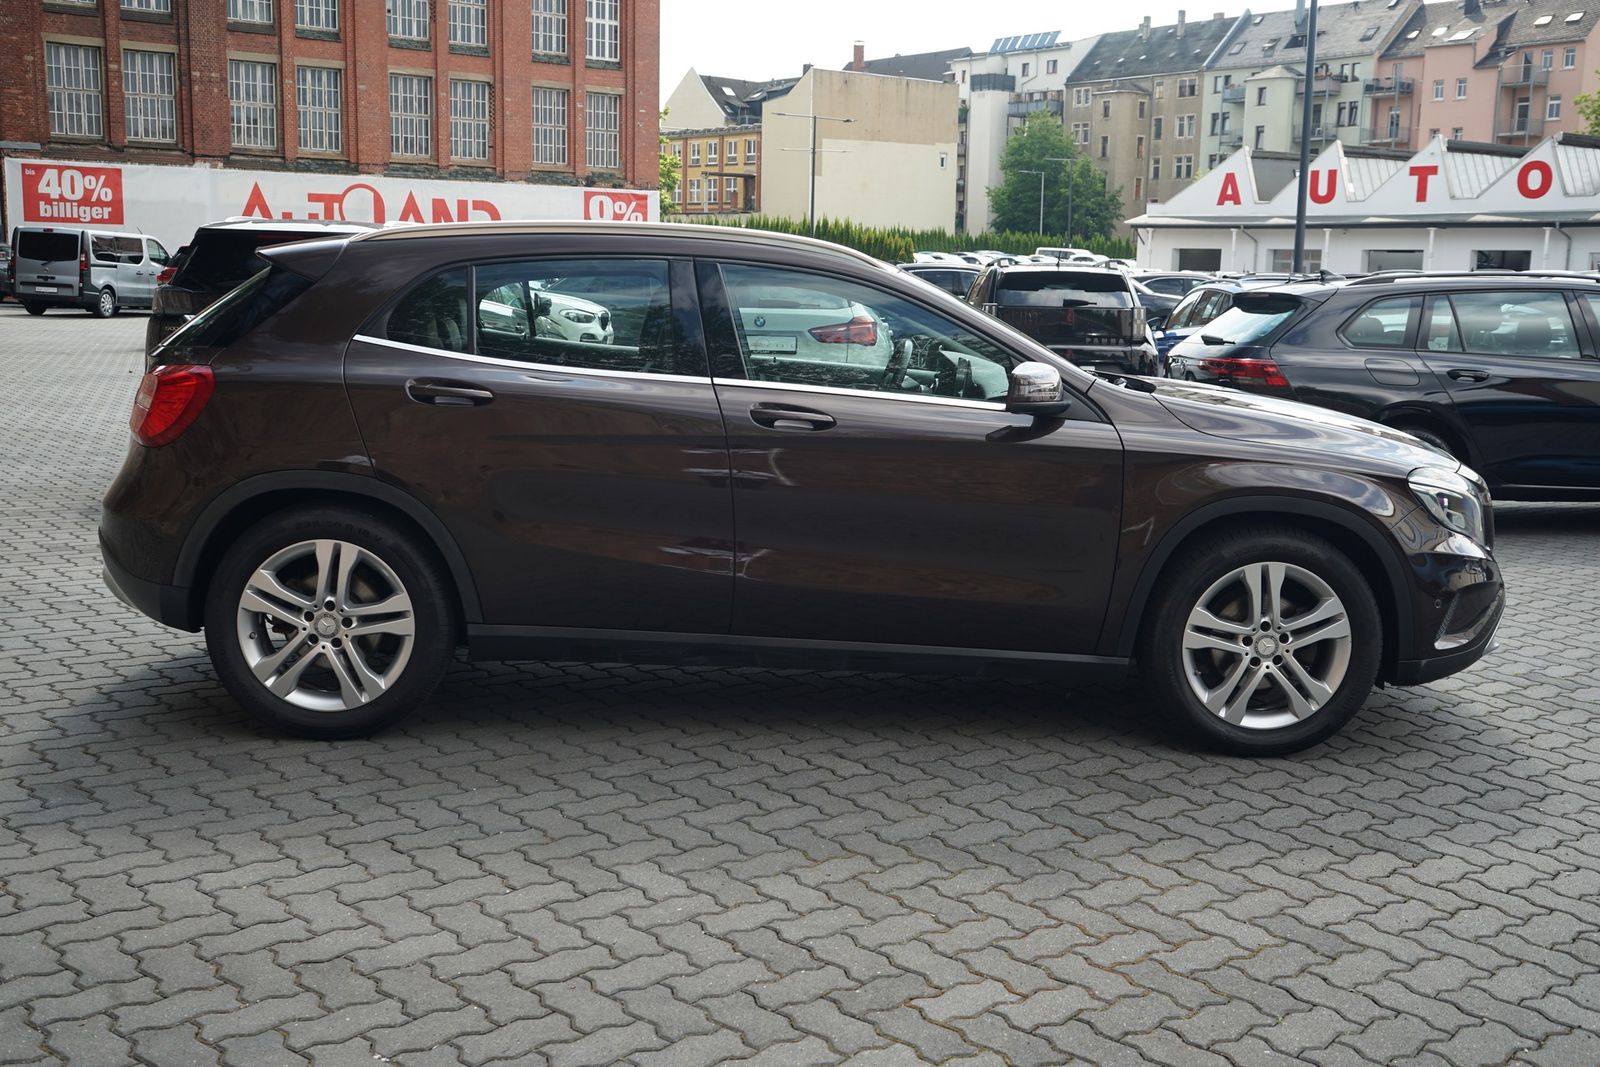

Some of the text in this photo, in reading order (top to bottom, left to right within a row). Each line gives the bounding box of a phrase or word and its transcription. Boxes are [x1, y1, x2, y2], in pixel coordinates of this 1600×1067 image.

[38, 168, 113, 202] 40%
[39, 201, 112, 222] billiger
[589, 194, 643, 222] 0%
